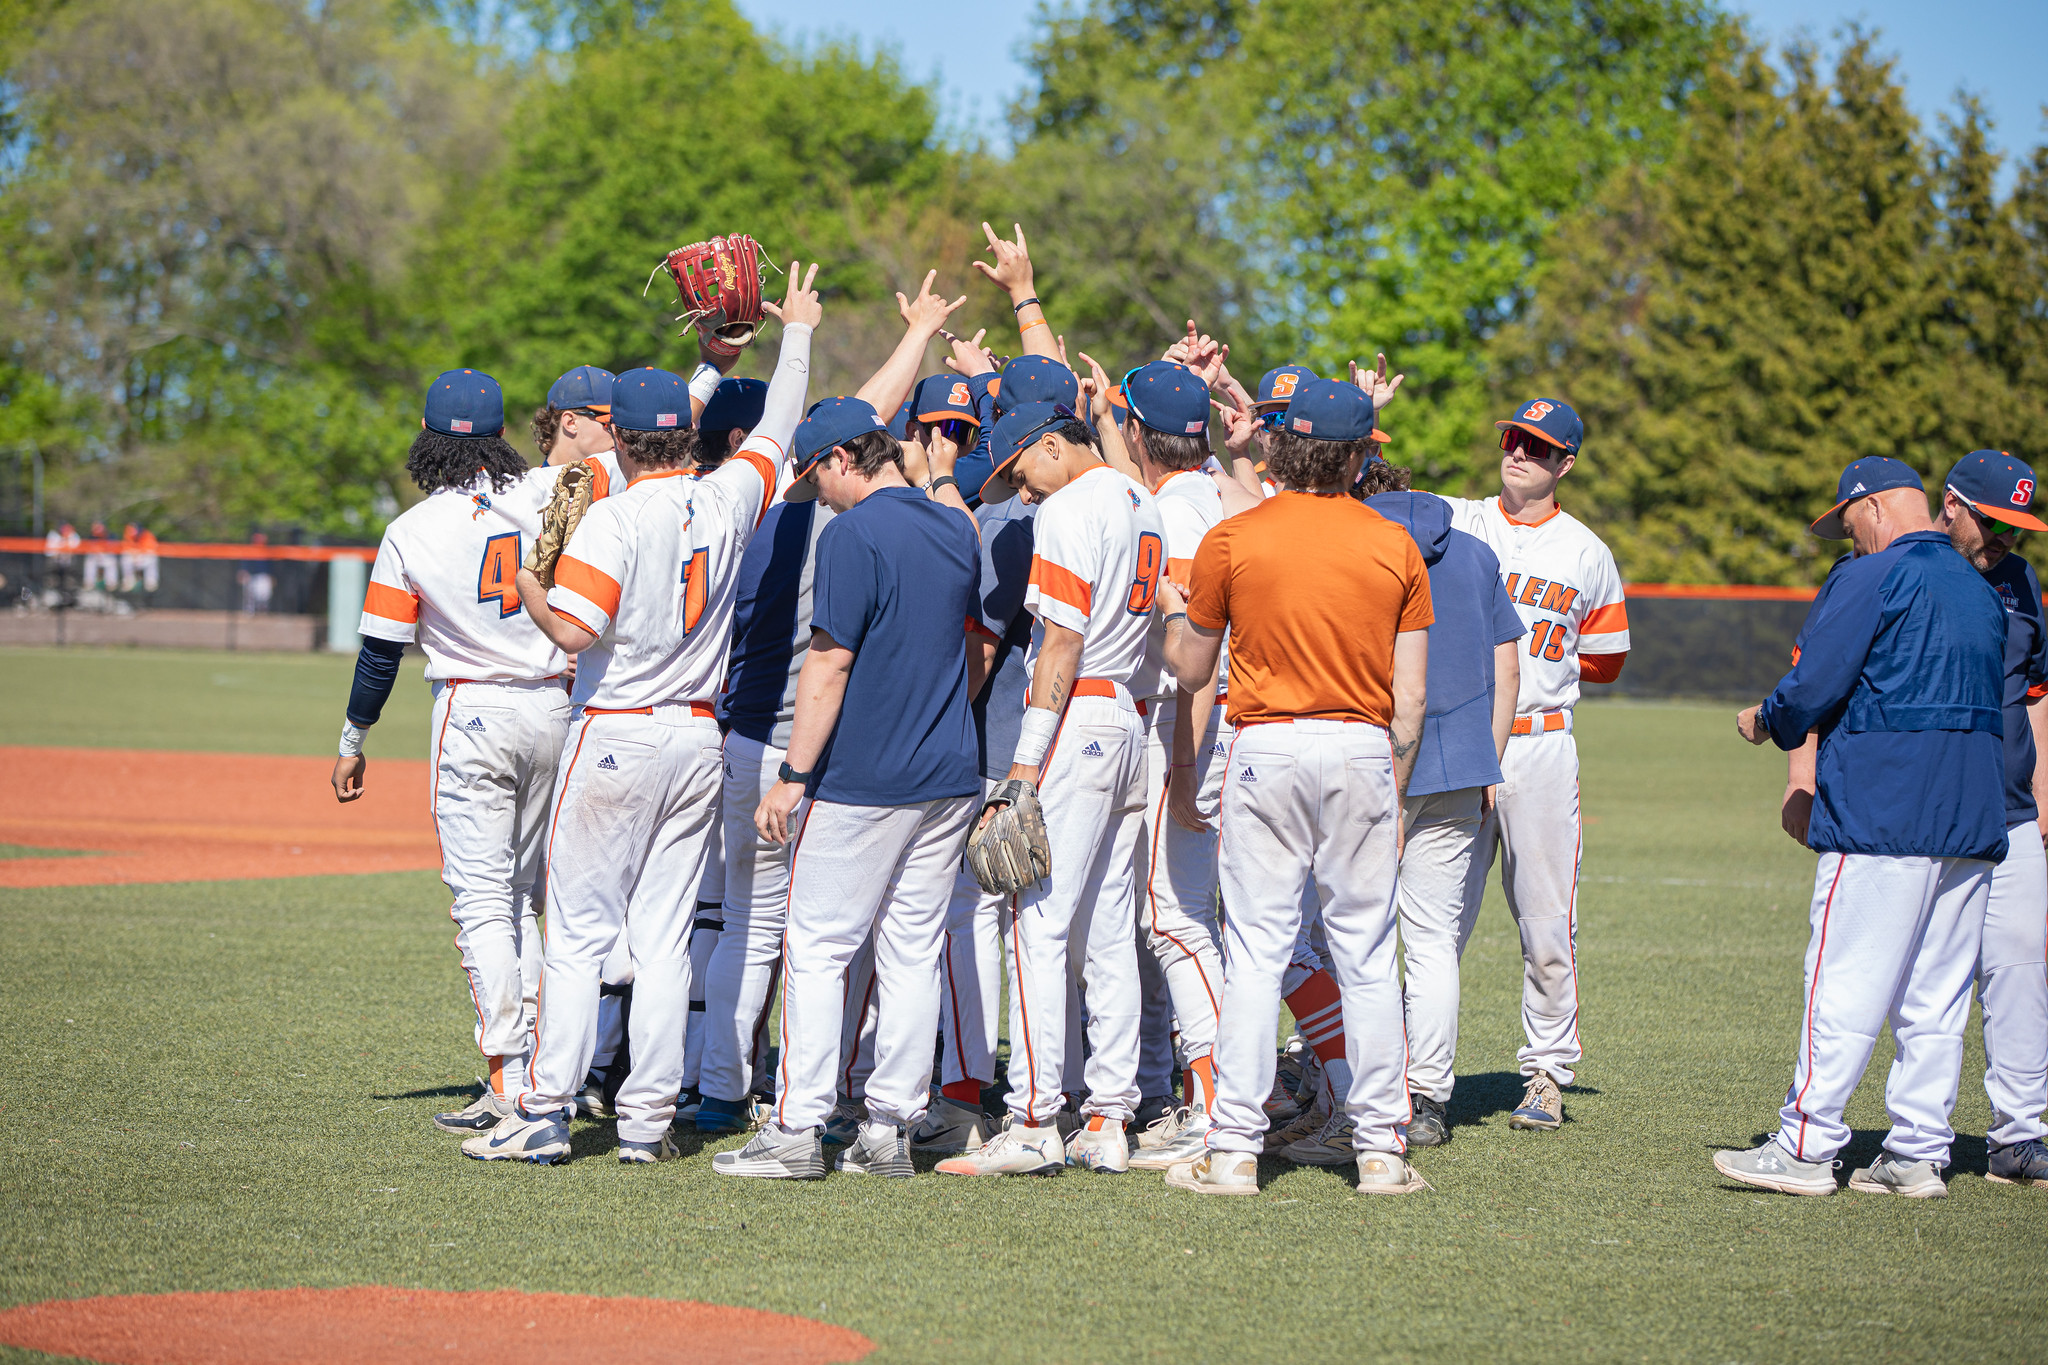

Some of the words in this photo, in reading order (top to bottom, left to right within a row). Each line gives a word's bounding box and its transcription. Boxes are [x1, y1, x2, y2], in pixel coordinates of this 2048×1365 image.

[720, 253, 736, 290] Rawlings
[947, 382, 971, 406] S
[1271, 373, 1299, 398] S
[1523, 401, 1554, 421] S
[2010, 479, 2033, 506] S
[478, 531, 522, 619] 4
[1127, 531, 1162, 616] 9
[680, 545, 709, 638] 1
[1499, 572, 1579, 616] LEM
[1051, 671, 1064, 705] NOT
[464, 724, 486, 733] adidas
[597, 761, 618, 771] adidas
[1081, 749, 1104, 758] adidas
[1239, 774, 1258, 783] adidas
